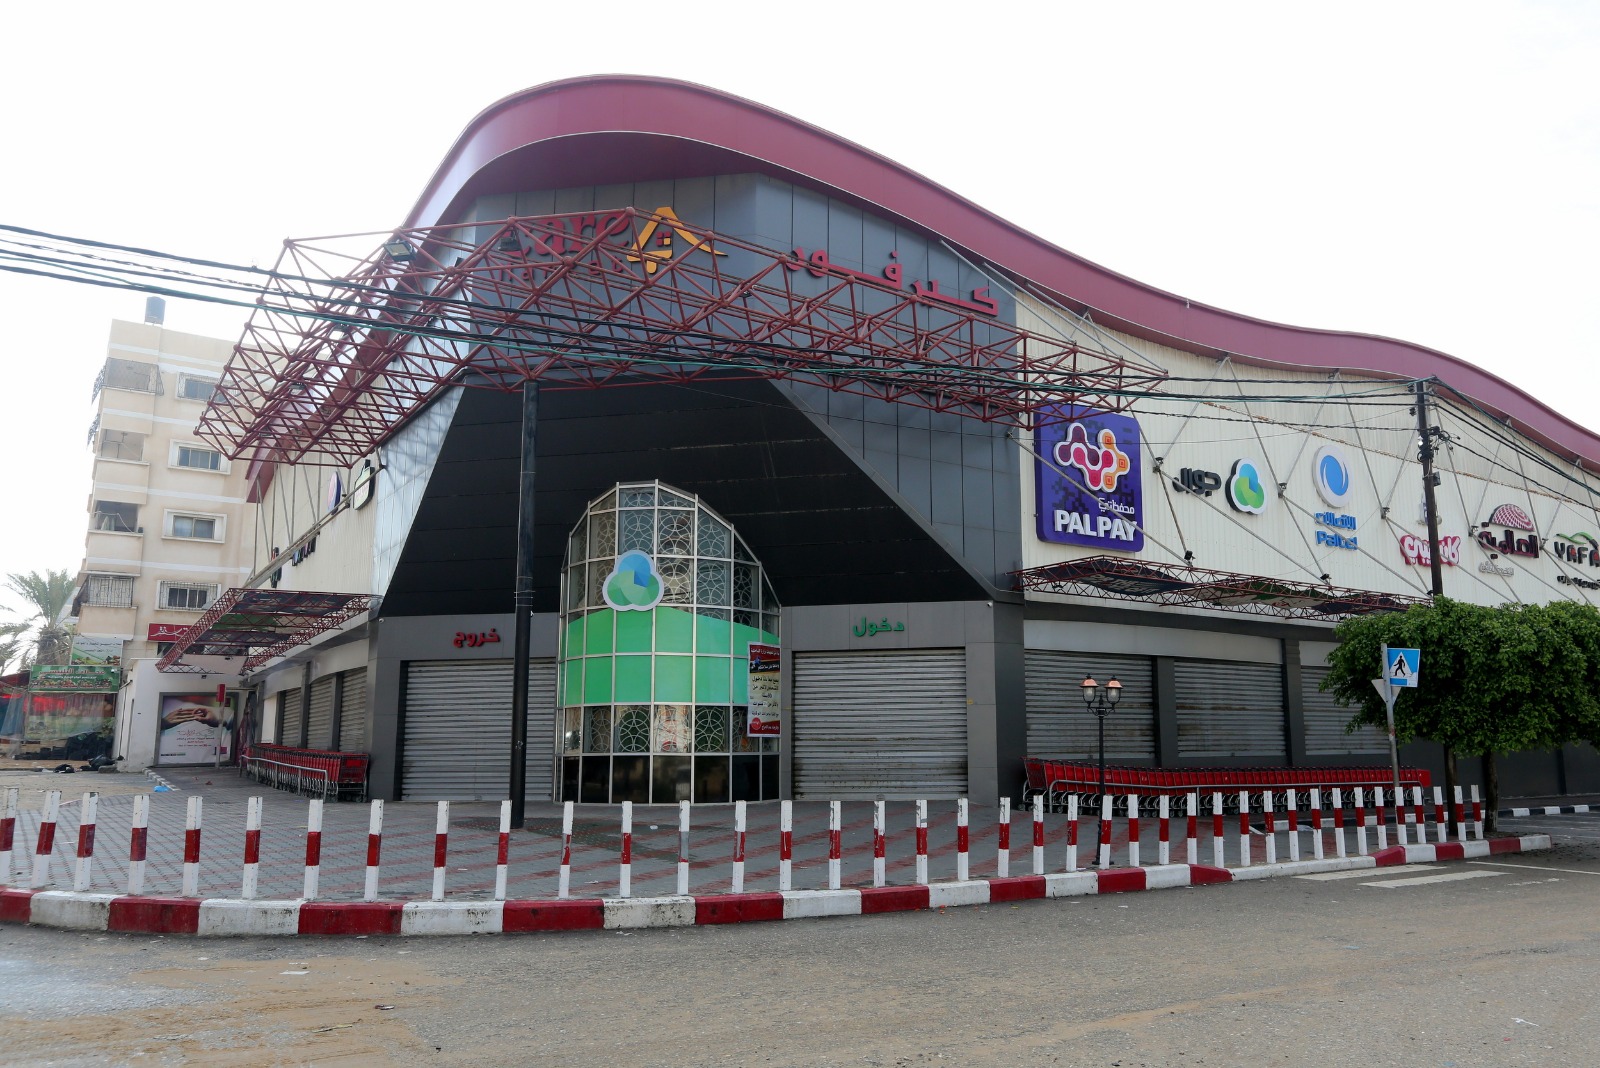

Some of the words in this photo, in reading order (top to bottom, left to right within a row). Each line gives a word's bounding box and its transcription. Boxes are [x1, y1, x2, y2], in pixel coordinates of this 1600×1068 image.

[1172, 467, 1222, 497] جوال
[1098, 497, 1135, 515] محفظتي
[1054, 509, 1137, 542] PALPAY
[1315, 530, 1358, 551] Paltel
[853, 617, 905, 637] دخول
[453, 628, 501, 649] خروج
